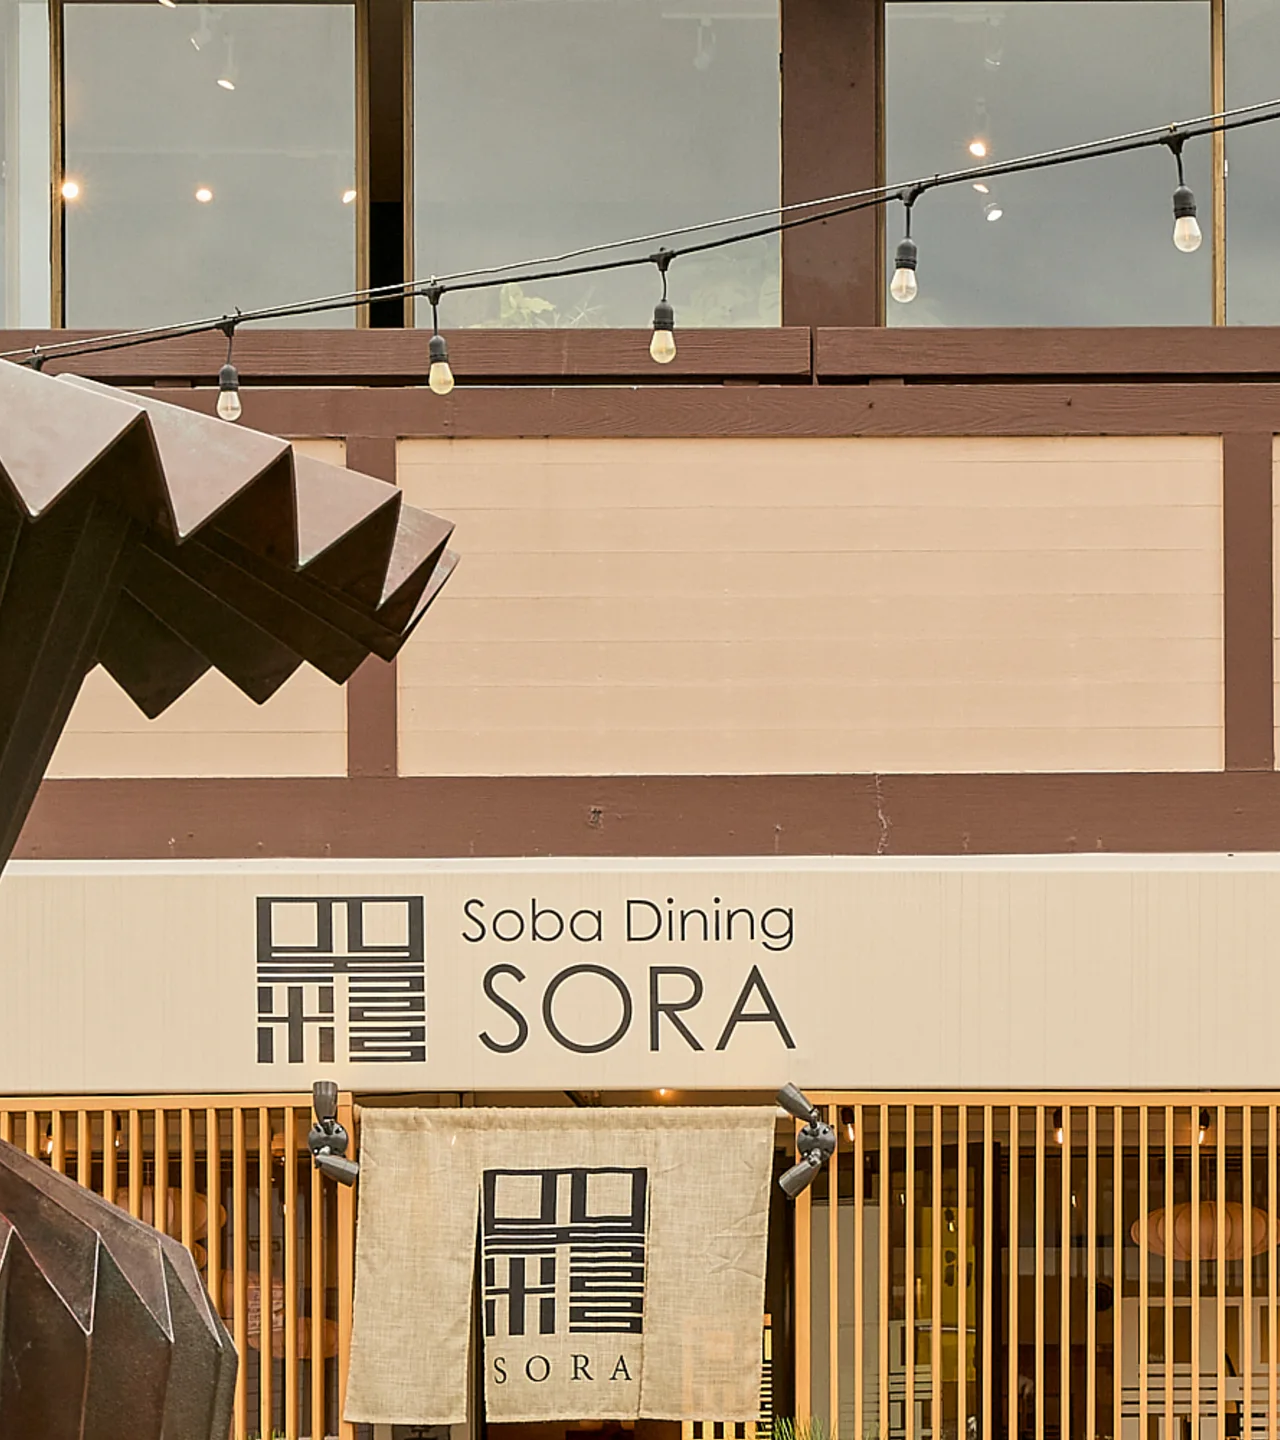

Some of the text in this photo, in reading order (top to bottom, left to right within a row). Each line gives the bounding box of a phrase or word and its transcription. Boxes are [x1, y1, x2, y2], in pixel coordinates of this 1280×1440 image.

[462, 896, 795, 952] Soba Dining
[478, 963, 797, 1055] SORA
[494, 1354, 633, 1385] SORA
